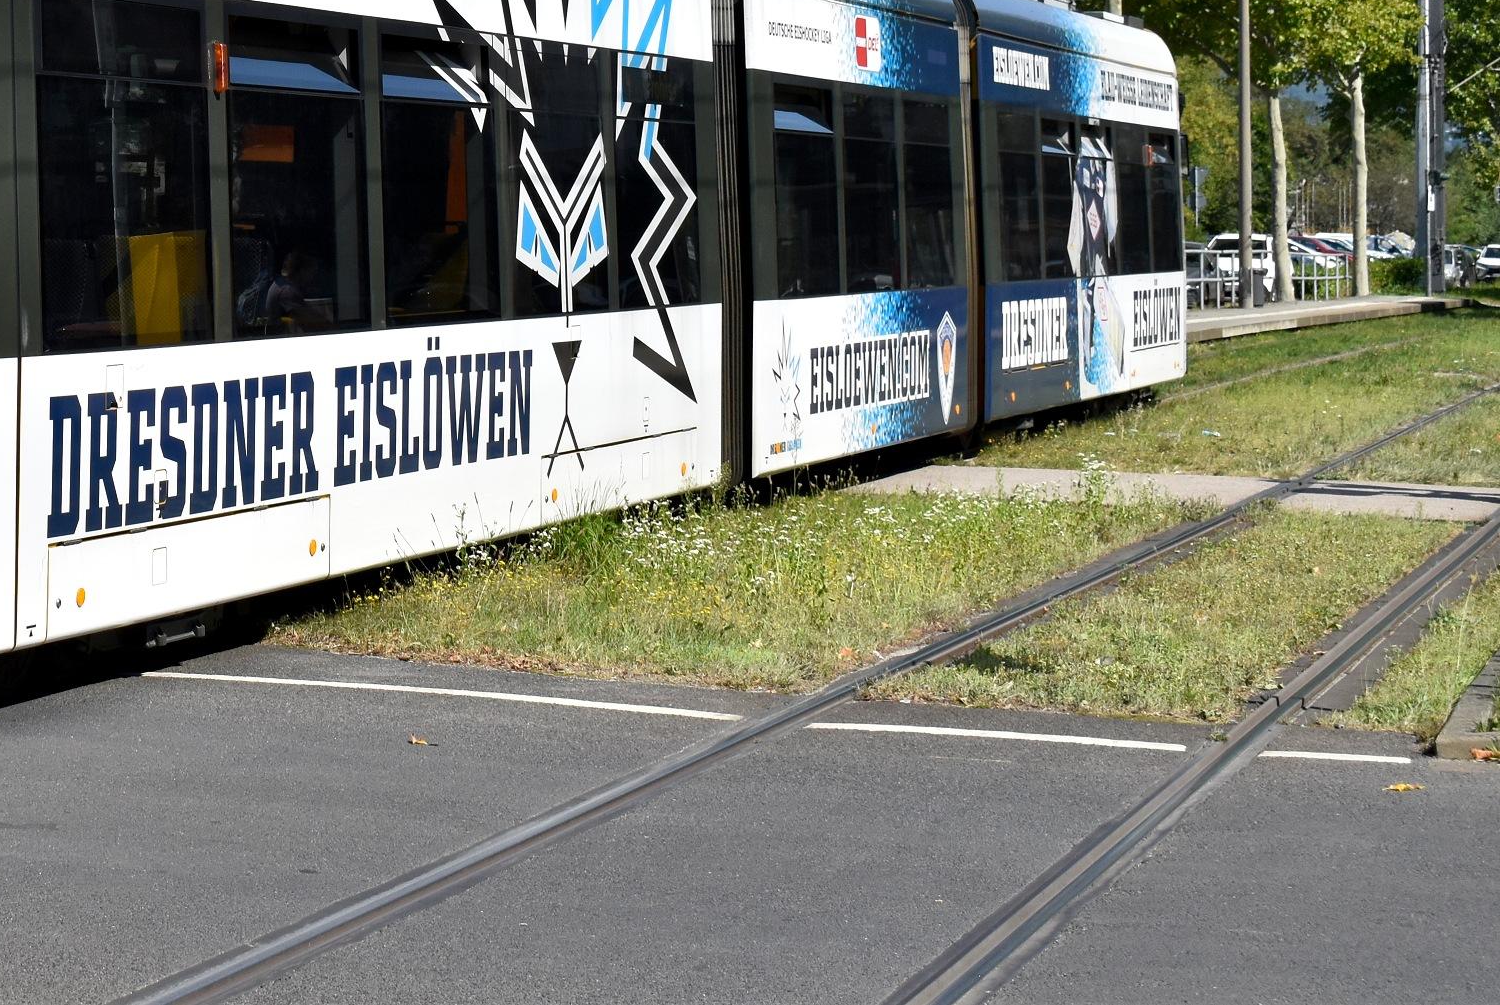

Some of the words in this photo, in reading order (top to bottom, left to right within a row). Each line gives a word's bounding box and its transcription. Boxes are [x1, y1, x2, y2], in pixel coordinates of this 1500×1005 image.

[768, 21, 793, 38] DEUTSCHE
[1001, 296, 1068, 370] DRESDNER
[1133, 278, 1181, 347] EISLÖWEN
[810, 334, 929, 415] EISLOEWEN.COM
[47, 371, 319, 539] DRESDNER
[334, 336, 533, 487] EISLÖWEN
